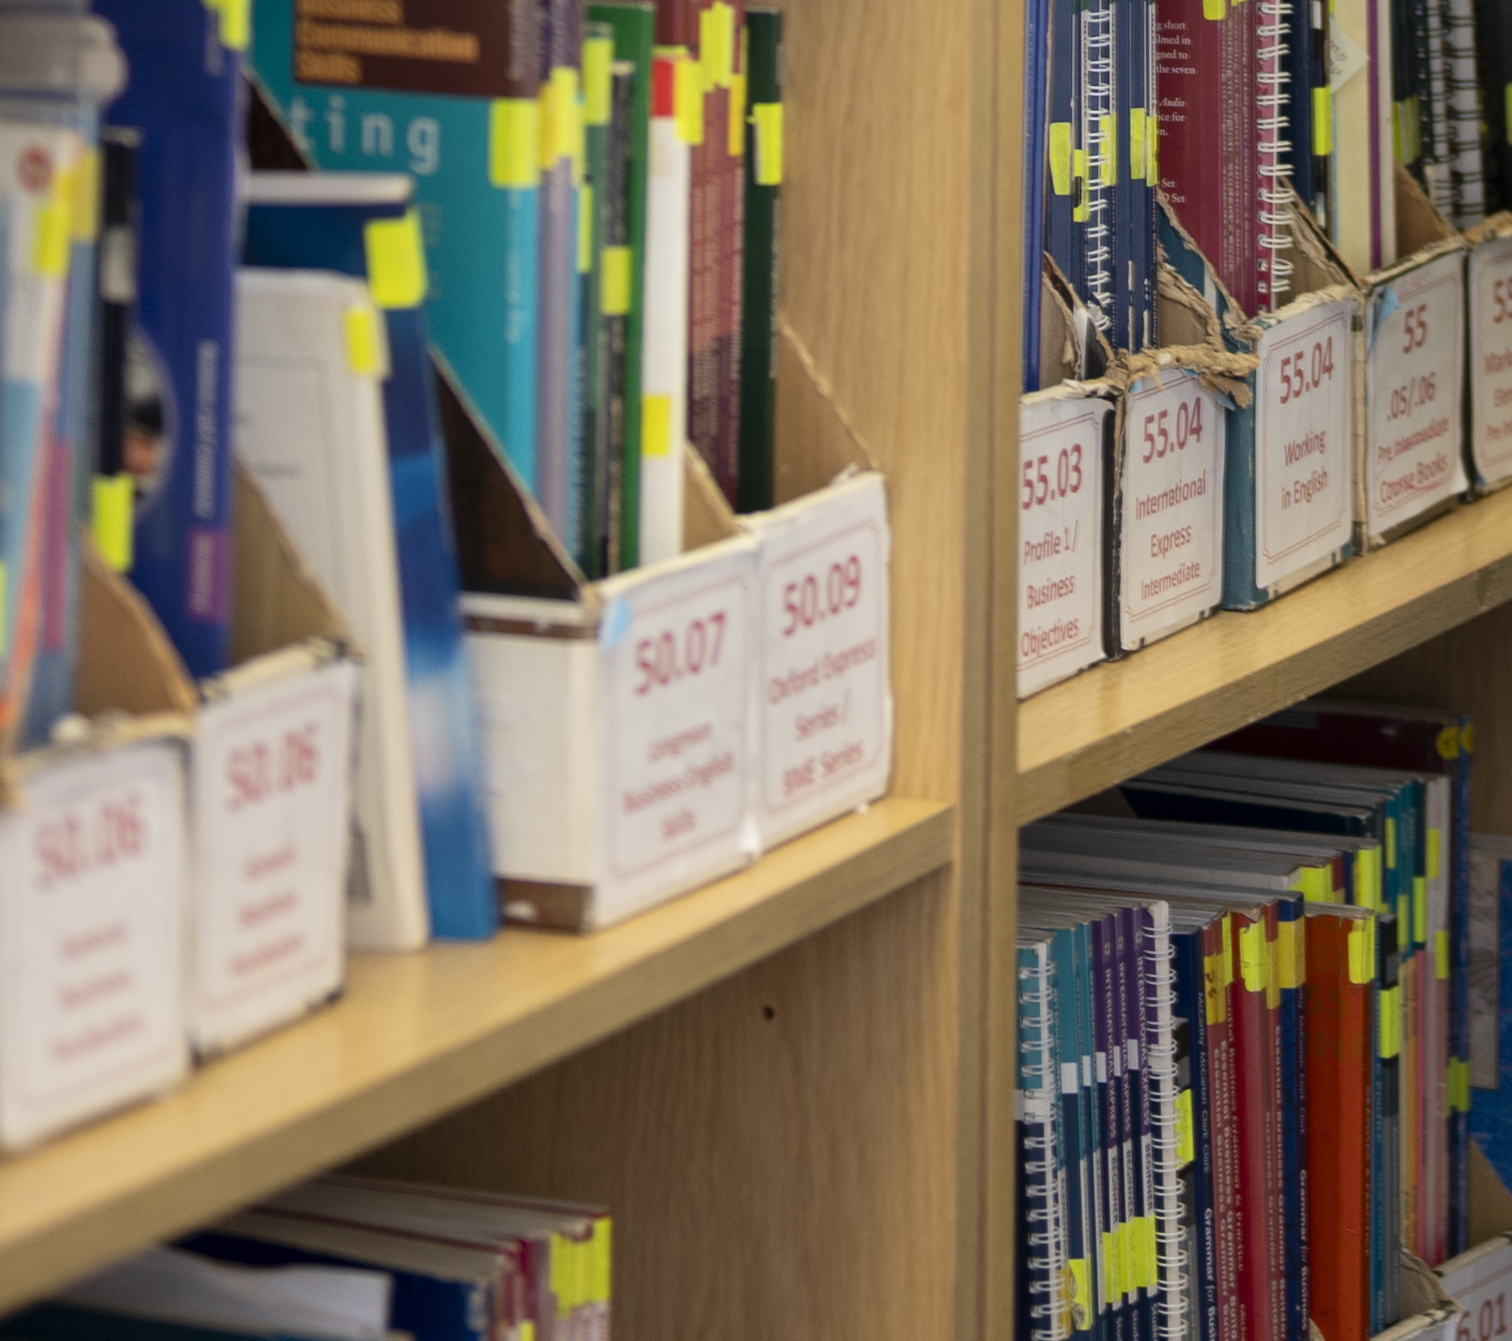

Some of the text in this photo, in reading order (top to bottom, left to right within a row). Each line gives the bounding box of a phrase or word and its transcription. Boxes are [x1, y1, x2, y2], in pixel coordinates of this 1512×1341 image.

[1163, 19, 1186, 30] short
[1171, 66, 1197, 75] seven
[1159, 97, 1186, 108] Audio
[1161, 178, 1176, 189] Set
[1171, 193, 1186, 204] Set
[1402, 303, 1428, 355] 55
[1279, 335, 1335, 405] 55.04
[1141, 395, 1203, 465] 55.04
[1284, 429, 1326, 467] Working
[1021, 442, 1083, 511] 55.03
[1135, 467, 1207, 521] International
[1281, 464, 1329, 511] in English
[1379, 453, 1448, 504] Course Books
[1023, 529, 1061, 566] Profile
[1150, 524, 1192, 560] Express
[782, 554, 862, 638] 50.09
[1026, 574, 1076, 610] Business
[1140, 560, 1201, 601] Intermediate
[633, 610, 728, 697] 50.07
[1020, 616, 1080, 658] Objectives
[1197, 992, 1206, 1045] McCarthy
[1104, 968, 1115, 1077] INTERNATIONAL
[1111, 1156, 1120, 1224] BEGINNER
[1118, 962, 1129, 1071] INTERNATIONAL
[1126, 1149, 1134, 1217] BEGINNER
[1137, 957, 1154, 1211] INTERNATIONAL EXPRESS BEGINNER
[1199, 1052, 1208, 1104] McCarten
[1204, 1207, 1215, 1281] Grammar
[1227, 1210, 1236, 1288] Grammar
[1204, 1284, 1216, 1303] for
